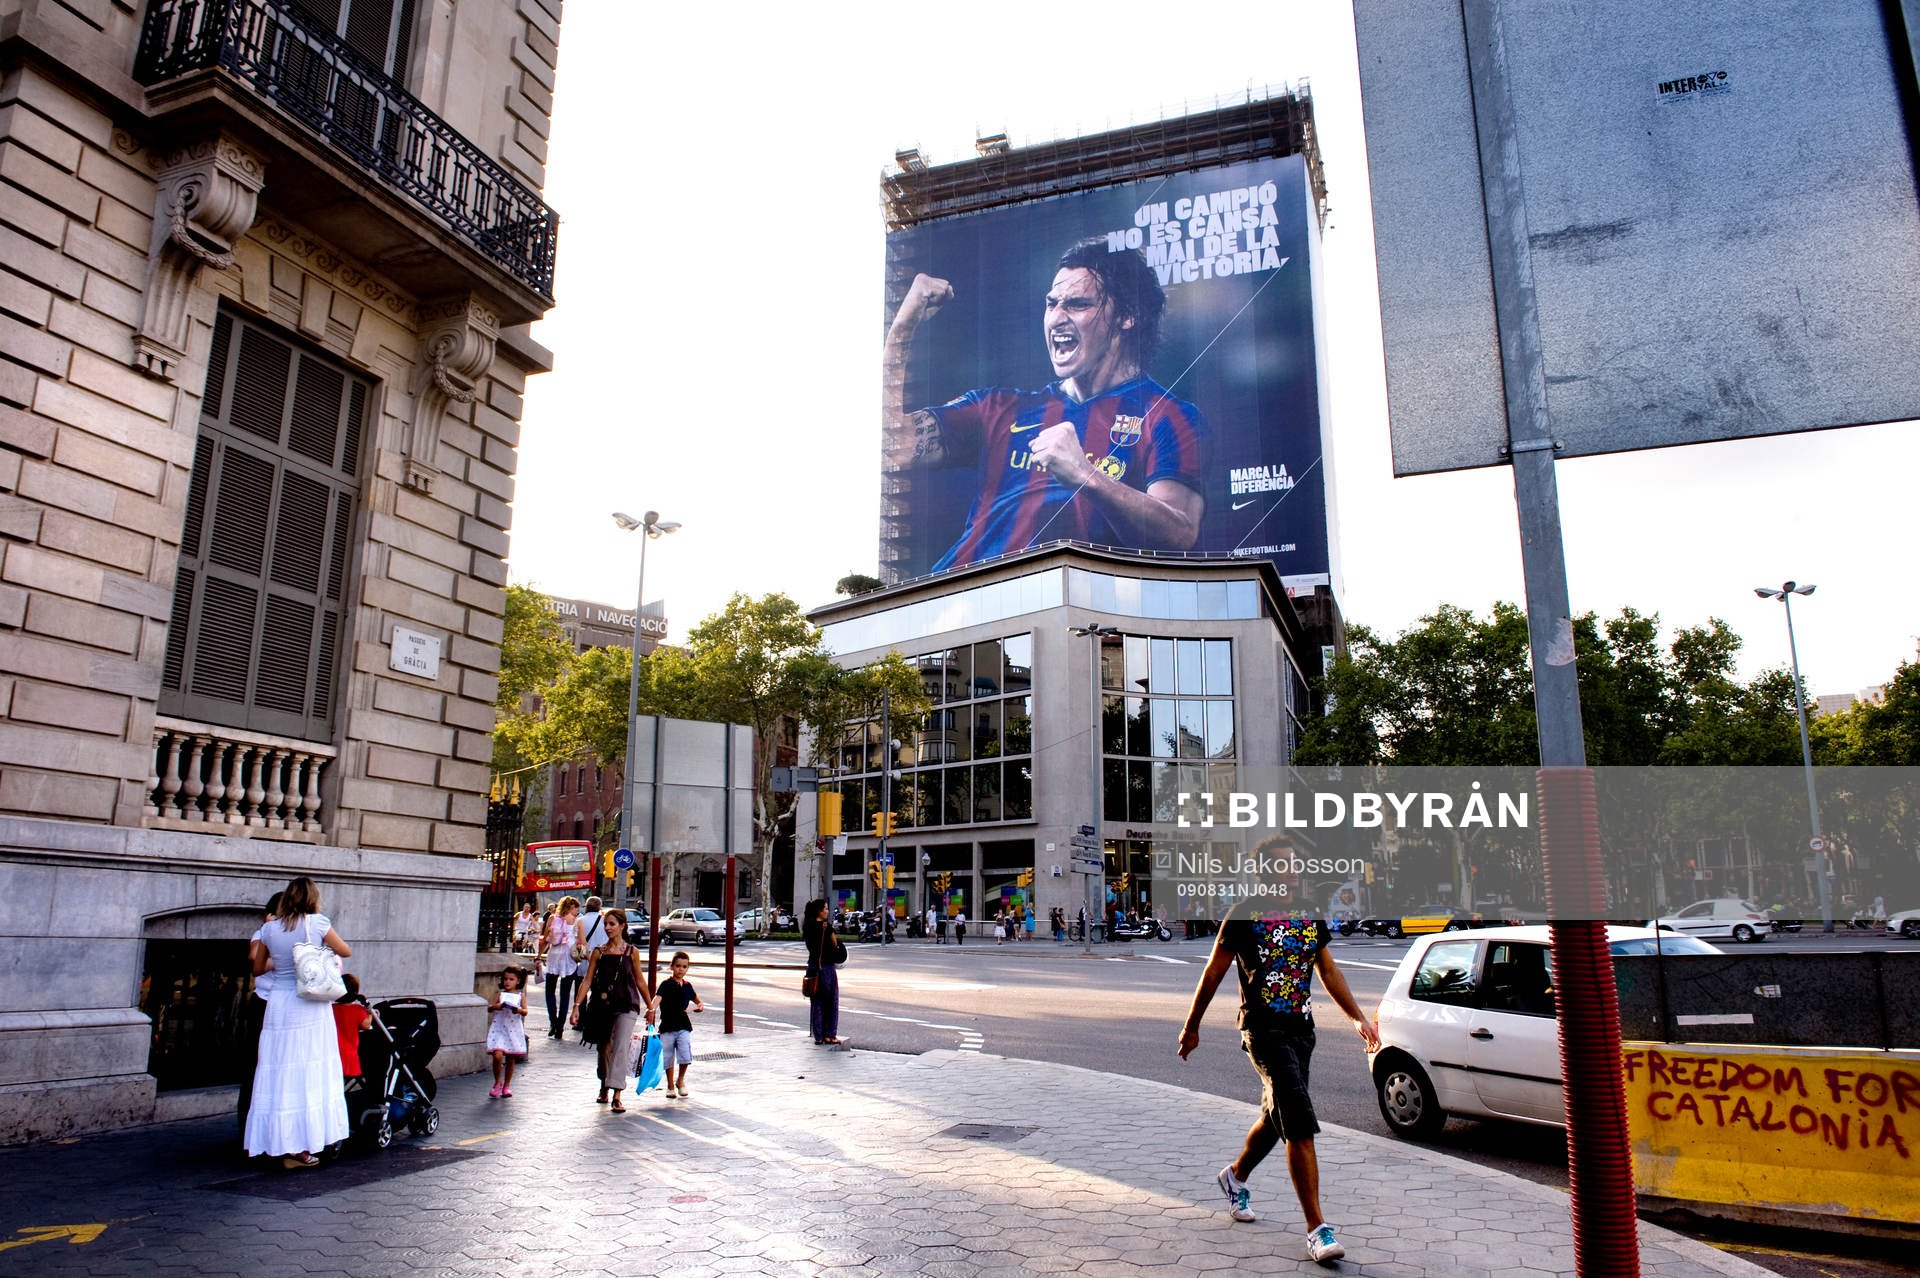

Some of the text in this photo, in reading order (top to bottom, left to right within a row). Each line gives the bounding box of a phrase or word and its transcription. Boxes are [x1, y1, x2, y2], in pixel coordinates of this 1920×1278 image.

[1134, 180, 1278, 227] UN CAMPIÓ
[1108, 204, 1279, 253] NO ES CANSA
[1146, 225, 1280, 268] MAI DE LA
[1230, 464, 1287, 482] MARCA LA
[1233, 543, 1296, 557] NIKEFOOTBALL.COM
[586, 607, 590, 619] I
[1126, 829, 1197, 841] Deutsche Bank
[1624, 1050, 1920, 1113] FREEDOM FOR
